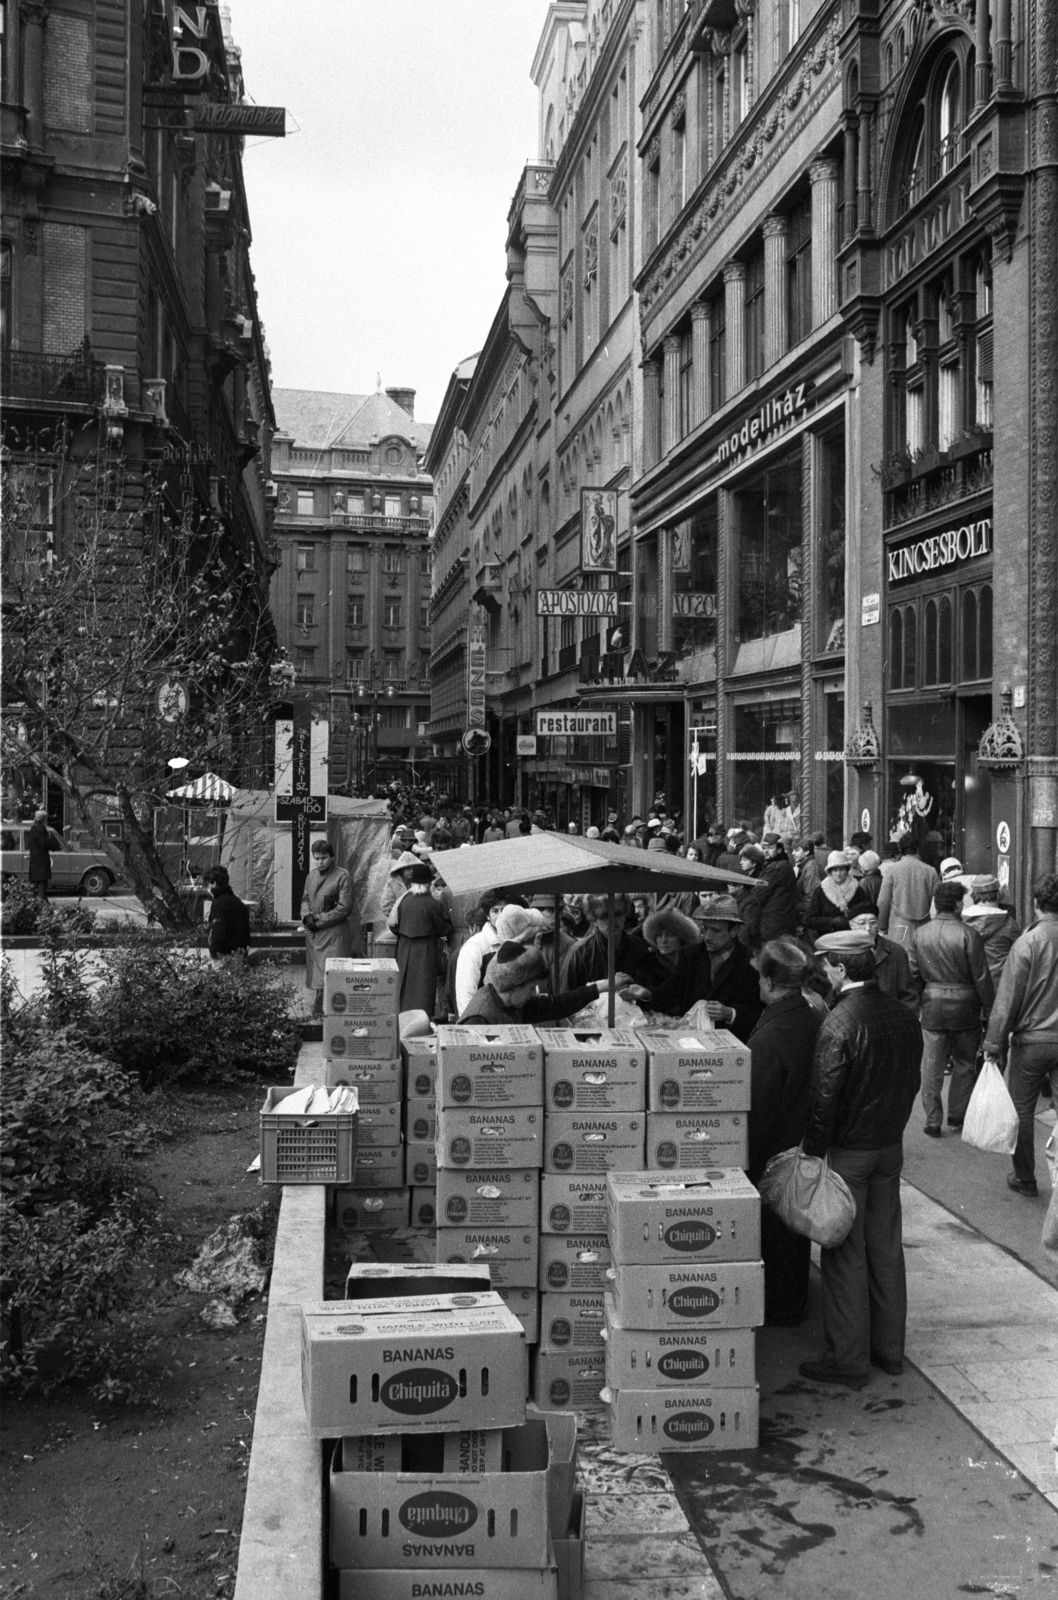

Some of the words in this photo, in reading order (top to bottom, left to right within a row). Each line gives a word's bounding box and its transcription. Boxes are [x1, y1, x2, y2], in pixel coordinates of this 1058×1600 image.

[718, 382, 806, 462] modellház
[888, 519, 991, 581] KINCSESBOLT
[539, 714, 614, 732] restaurant
[469, 1052, 516, 1062] BANANAS
[678, 1058, 724, 1067] BANANAS
[572, 1059, 618, 1068] BANANAS
[469, 1115, 515, 1124] BANANAS
[675, 1119, 720, 1129] BANANAS
[572, 1121, 618, 1131] BANANAS
[465, 1174, 511, 1183] BANANAS
[665, 1207, 714, 1217] BANANAS
[465, 1235, 511, 1244] BANANAS
[669, 1228, 711, 1244] Chiquita
[669, 1273, 718, 1283] BANANAS
[673, 1295, 715, 1310] Chiquita
[659, 1336, 707, 1346] BANANAS
[382, 1346, 455, 1363] BANANAS
[663, 1357, 705, 1372] Chiquita
[388, 1380, 450, 1403] Chiquita
[664, 1398, 712, 1409] BANANAS
[668, 1420, 710, 1434] Chiquita
[366, 1448, 373, 1459] OR
[479, 1448, 486, 1457] AT
[407, 1503, 469, 1525] Chiquita
[402, 1544, 475, 1557] BANANAS
[411, 1582, 485, 1597] BANANAS
